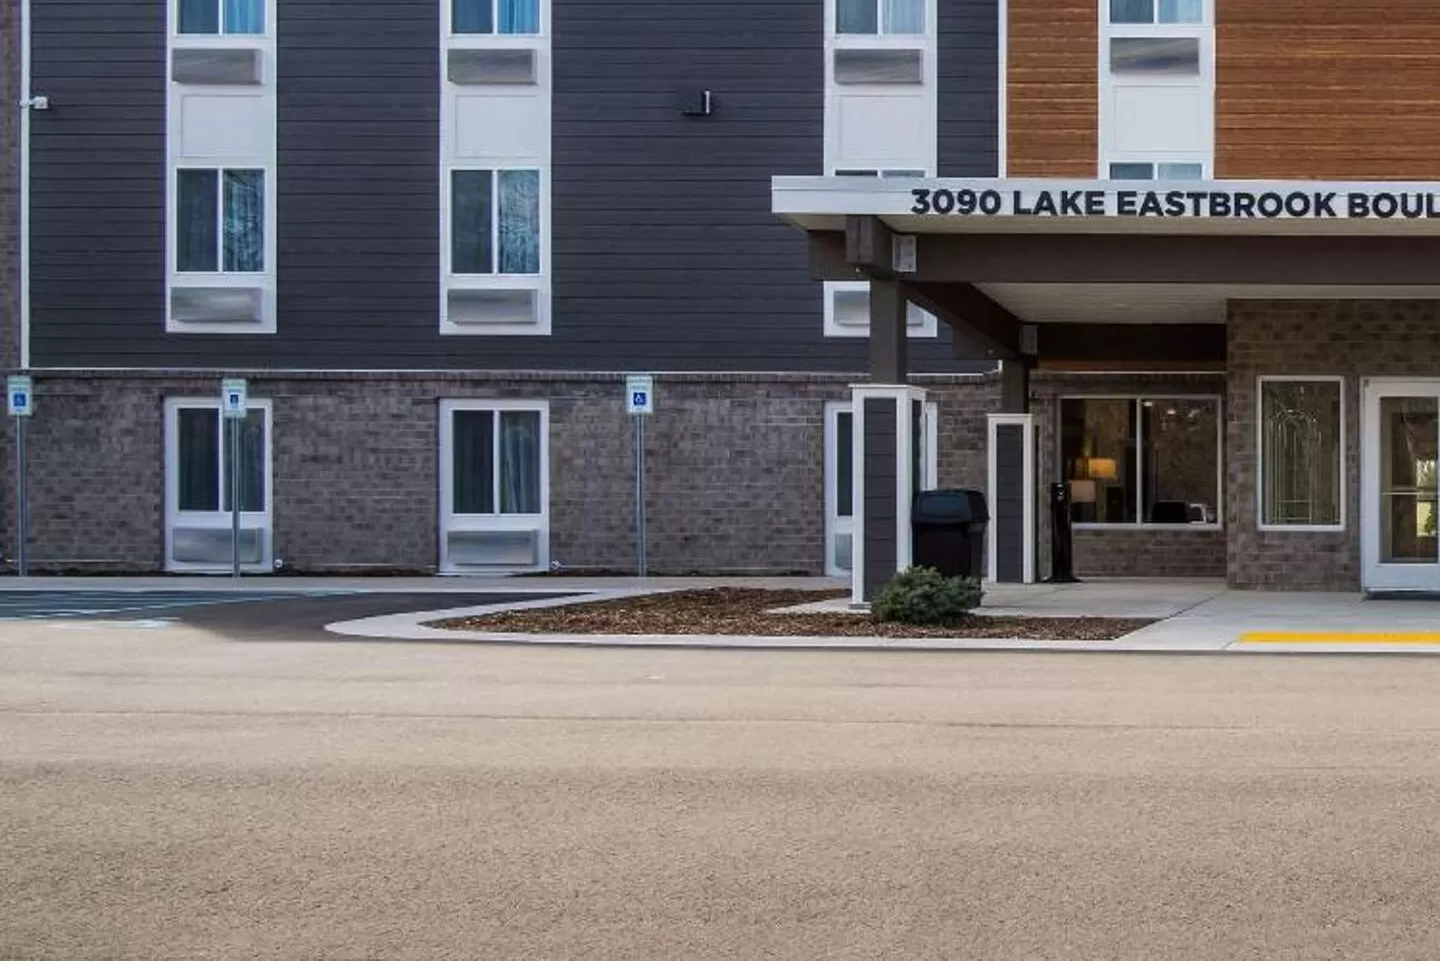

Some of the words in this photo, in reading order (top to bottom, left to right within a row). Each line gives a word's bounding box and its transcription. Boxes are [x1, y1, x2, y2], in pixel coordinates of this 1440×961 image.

[910, 188, 1002, 215] 3090
[1012, 190, 1106, 216] LAKE
[1116, 190, 1337, 218] EASTBROOK
